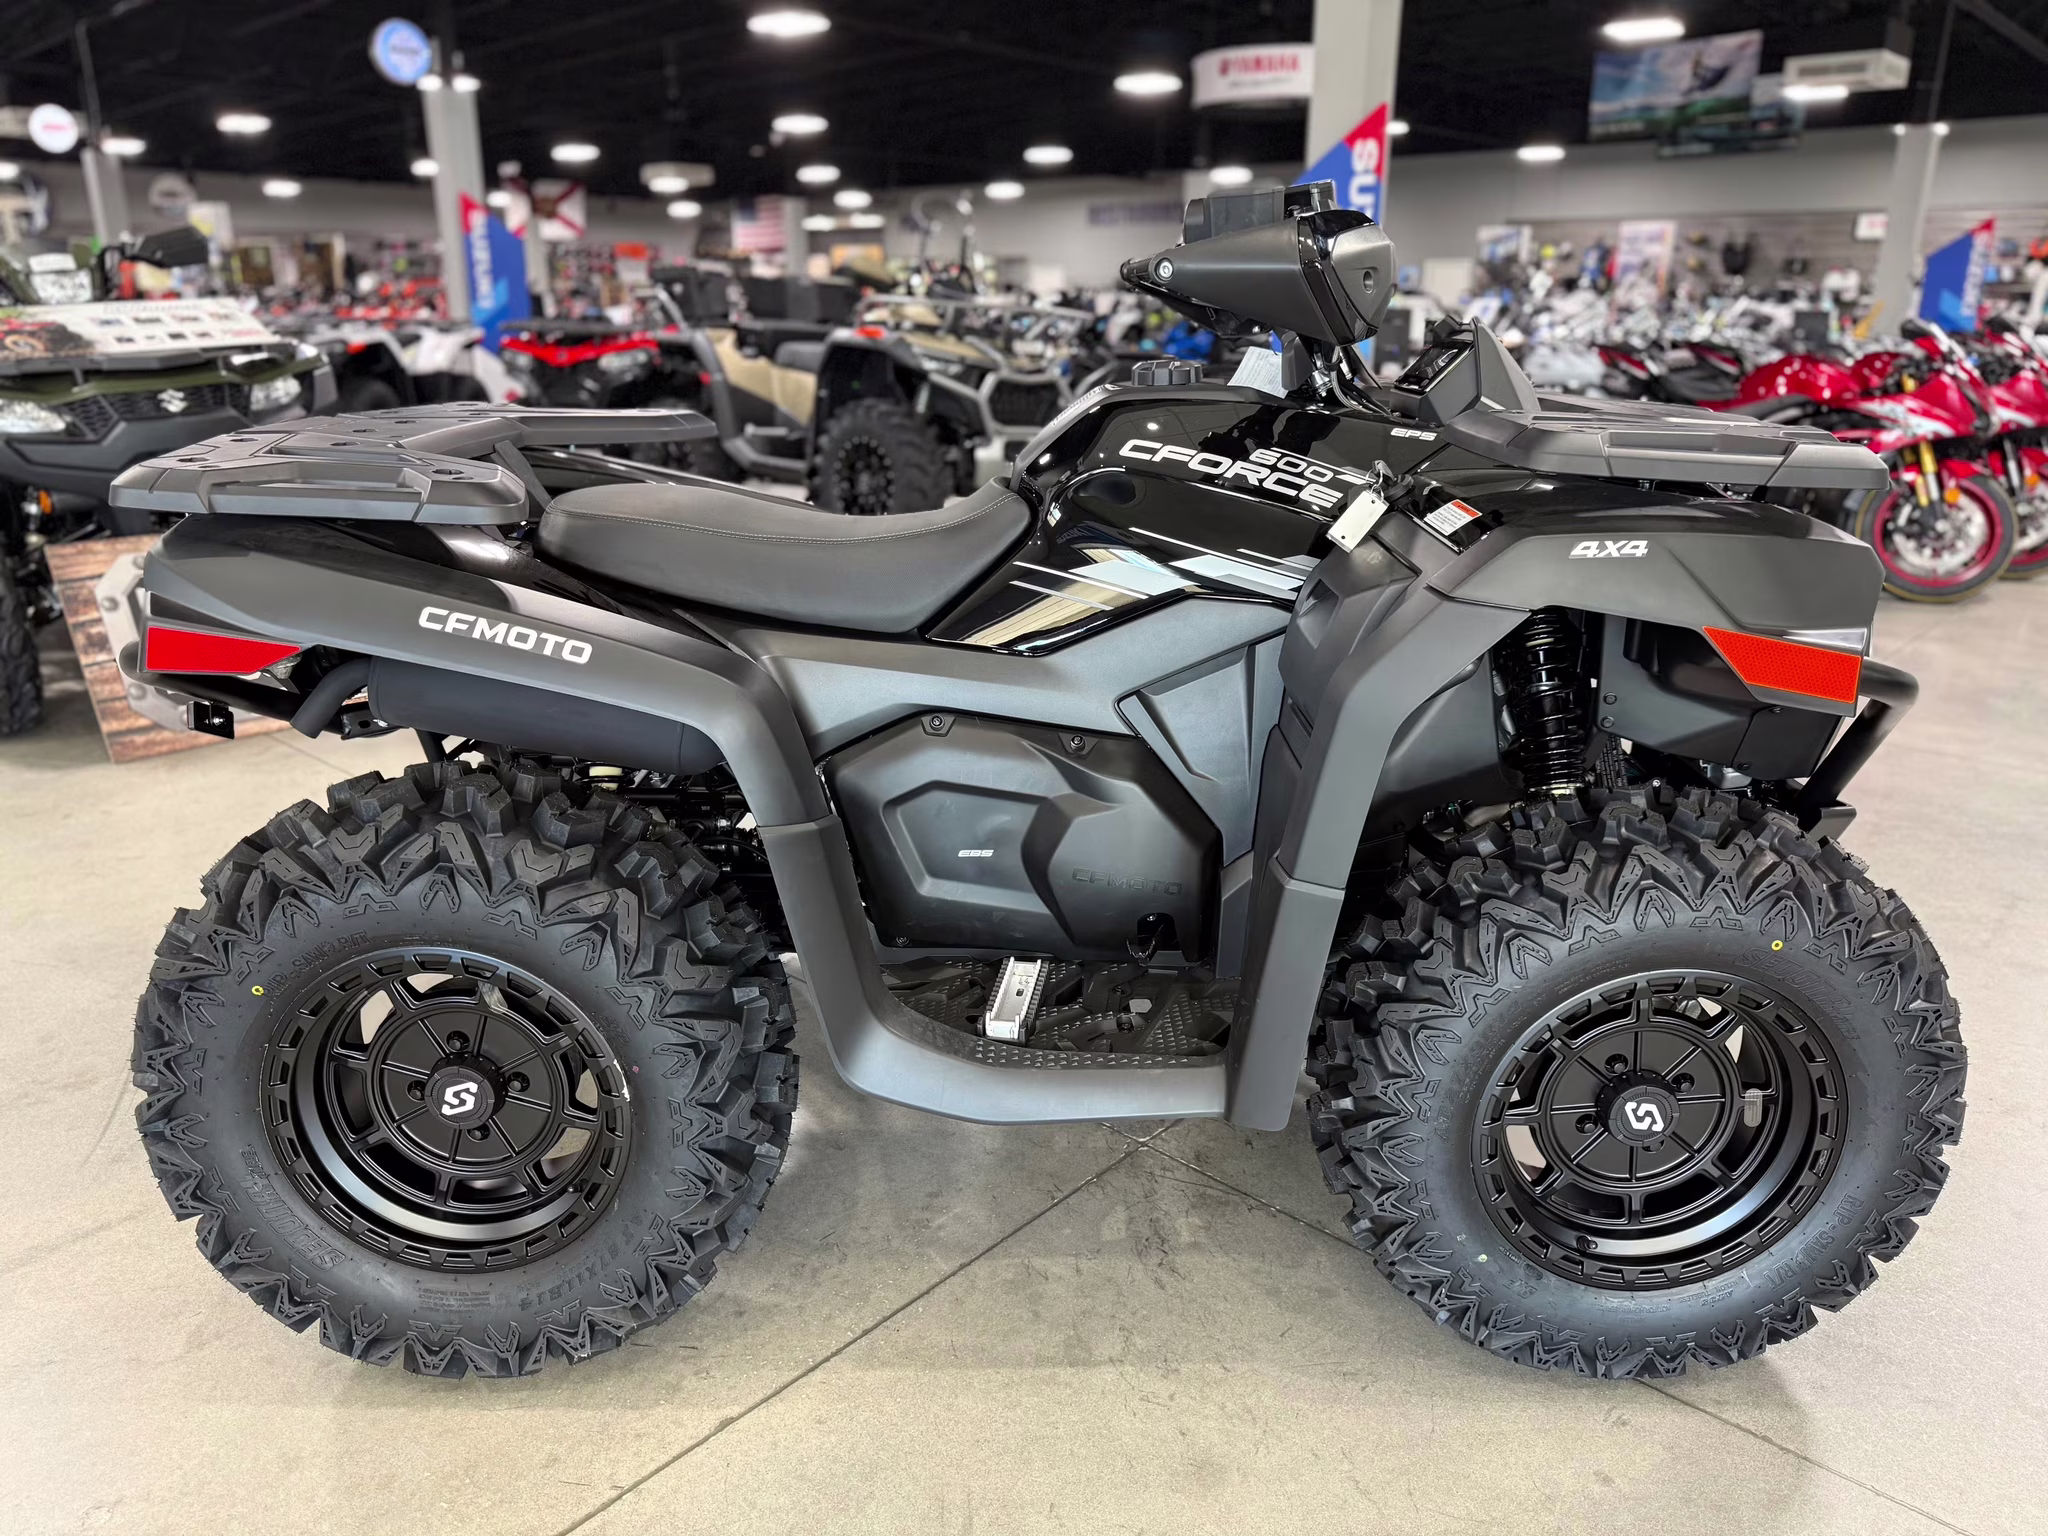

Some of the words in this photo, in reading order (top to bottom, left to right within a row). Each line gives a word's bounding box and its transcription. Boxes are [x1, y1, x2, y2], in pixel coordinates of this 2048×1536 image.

[1390, 428, 1438, 442] EPS
[1119, 439, 1344, 509] CFORCE
[1569, 540, 1649, 558] 4X4
[418, 606, 593, 665] CFMOTO
[958, 849, 994, 858] EBS
[1072, 868, 1183, 896] CFMOTO
